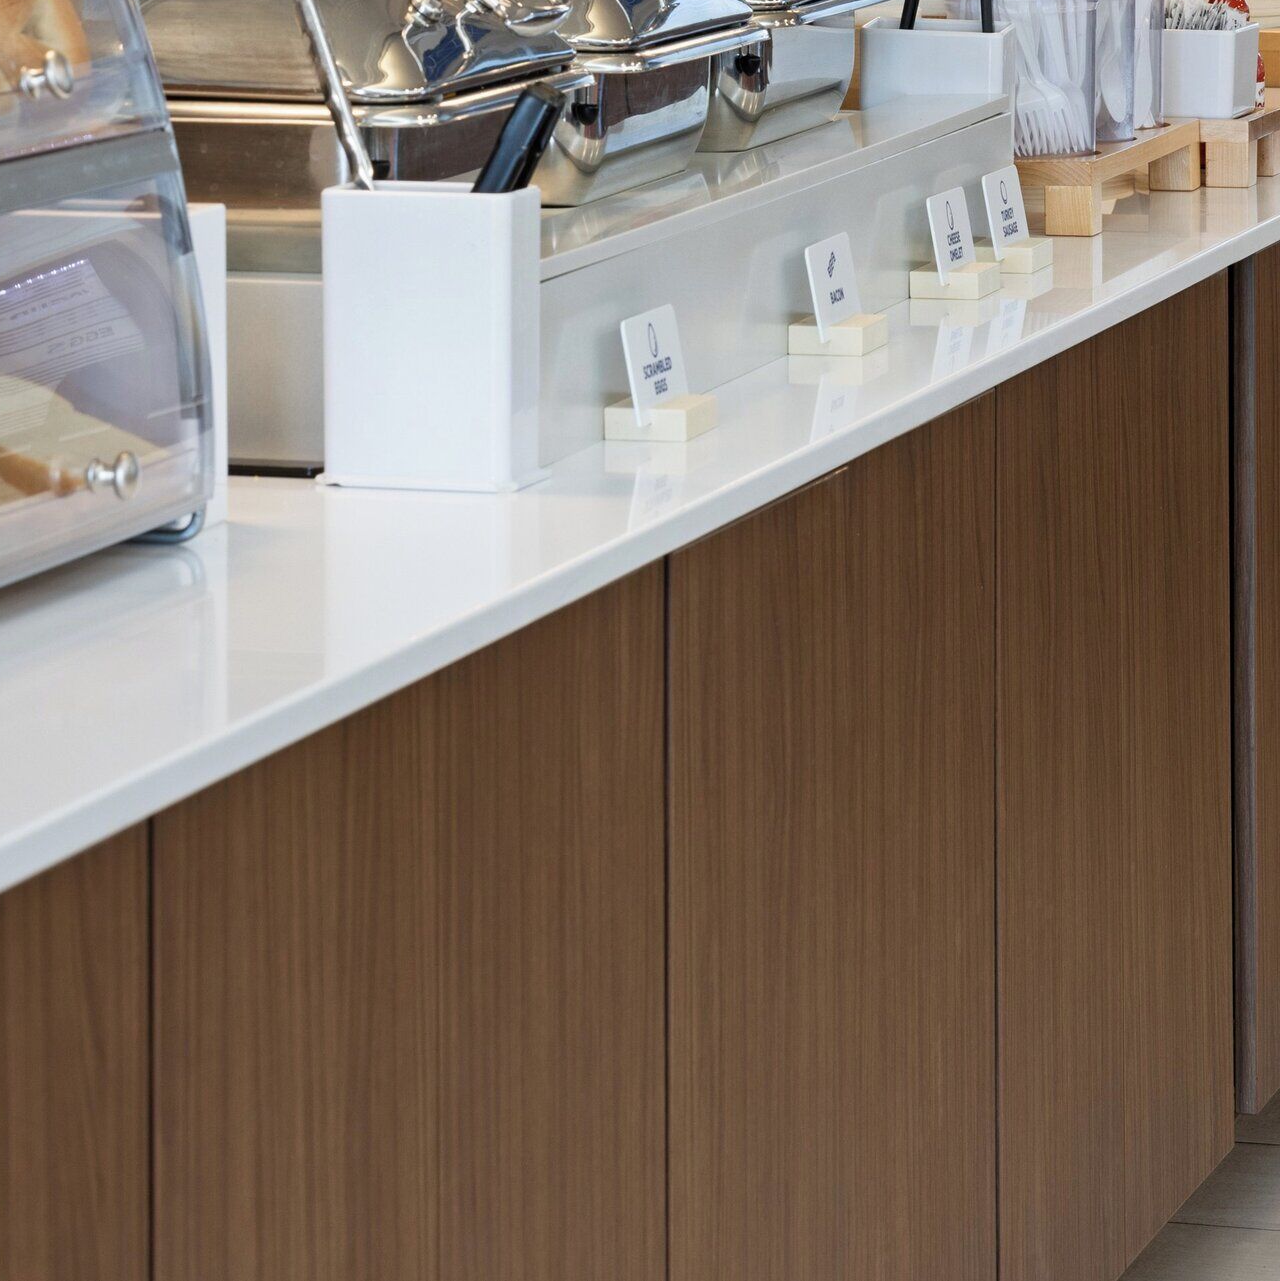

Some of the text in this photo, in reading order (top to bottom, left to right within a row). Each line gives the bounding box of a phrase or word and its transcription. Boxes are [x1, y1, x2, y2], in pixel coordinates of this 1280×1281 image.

[1001, 208, 1015, 221] TURKEY
[1003, 221, 1019, 238] SAUSAGE
[947, 231, 962, 247] CHEESE
[829, 287, 845, 305] BACON
[642, 356, 672, 380] SCRAMBLED
